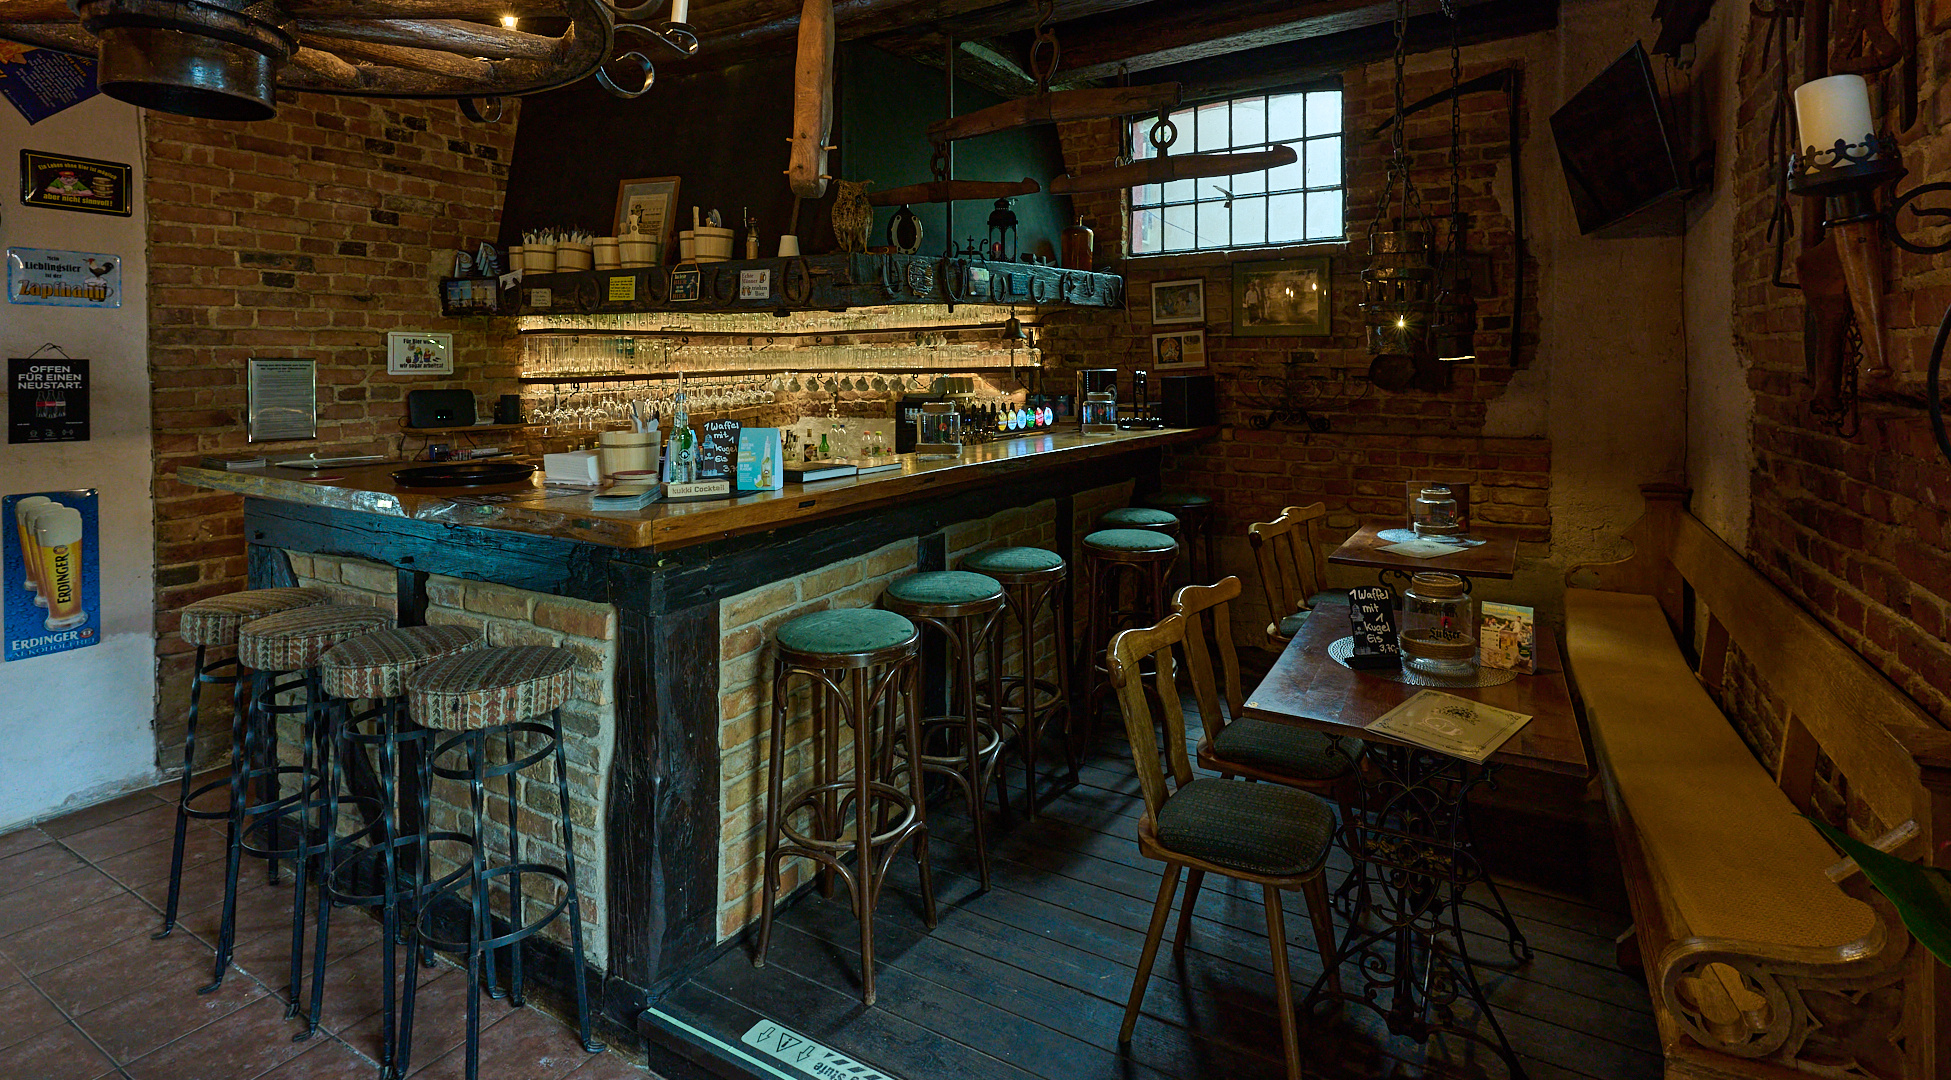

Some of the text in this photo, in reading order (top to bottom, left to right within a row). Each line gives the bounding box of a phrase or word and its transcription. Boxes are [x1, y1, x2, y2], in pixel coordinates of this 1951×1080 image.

[97, 168, 117, 180] möglich
[82, 198, 112, 207] sinnvoll!
[25, 262, 81, 272] Lieblingstier
[18, 280, 106, 299] Zapfhahn
[18, 372, 43, 381] FÜR
[704, 421, 739, 431] 1 Waffel
[694, 484, 725, 492] Cocktail
[56, 553, 72, 604] ERDINGER
[1349, 588, 1389, 601] 1 Waffel
[1362, 603, 1379, 613] mit
[1376, 613, 1383, 622] 1
[12, 631, 79, 651] ERDINGER
[1367, 634, 1383, 643] Eis
